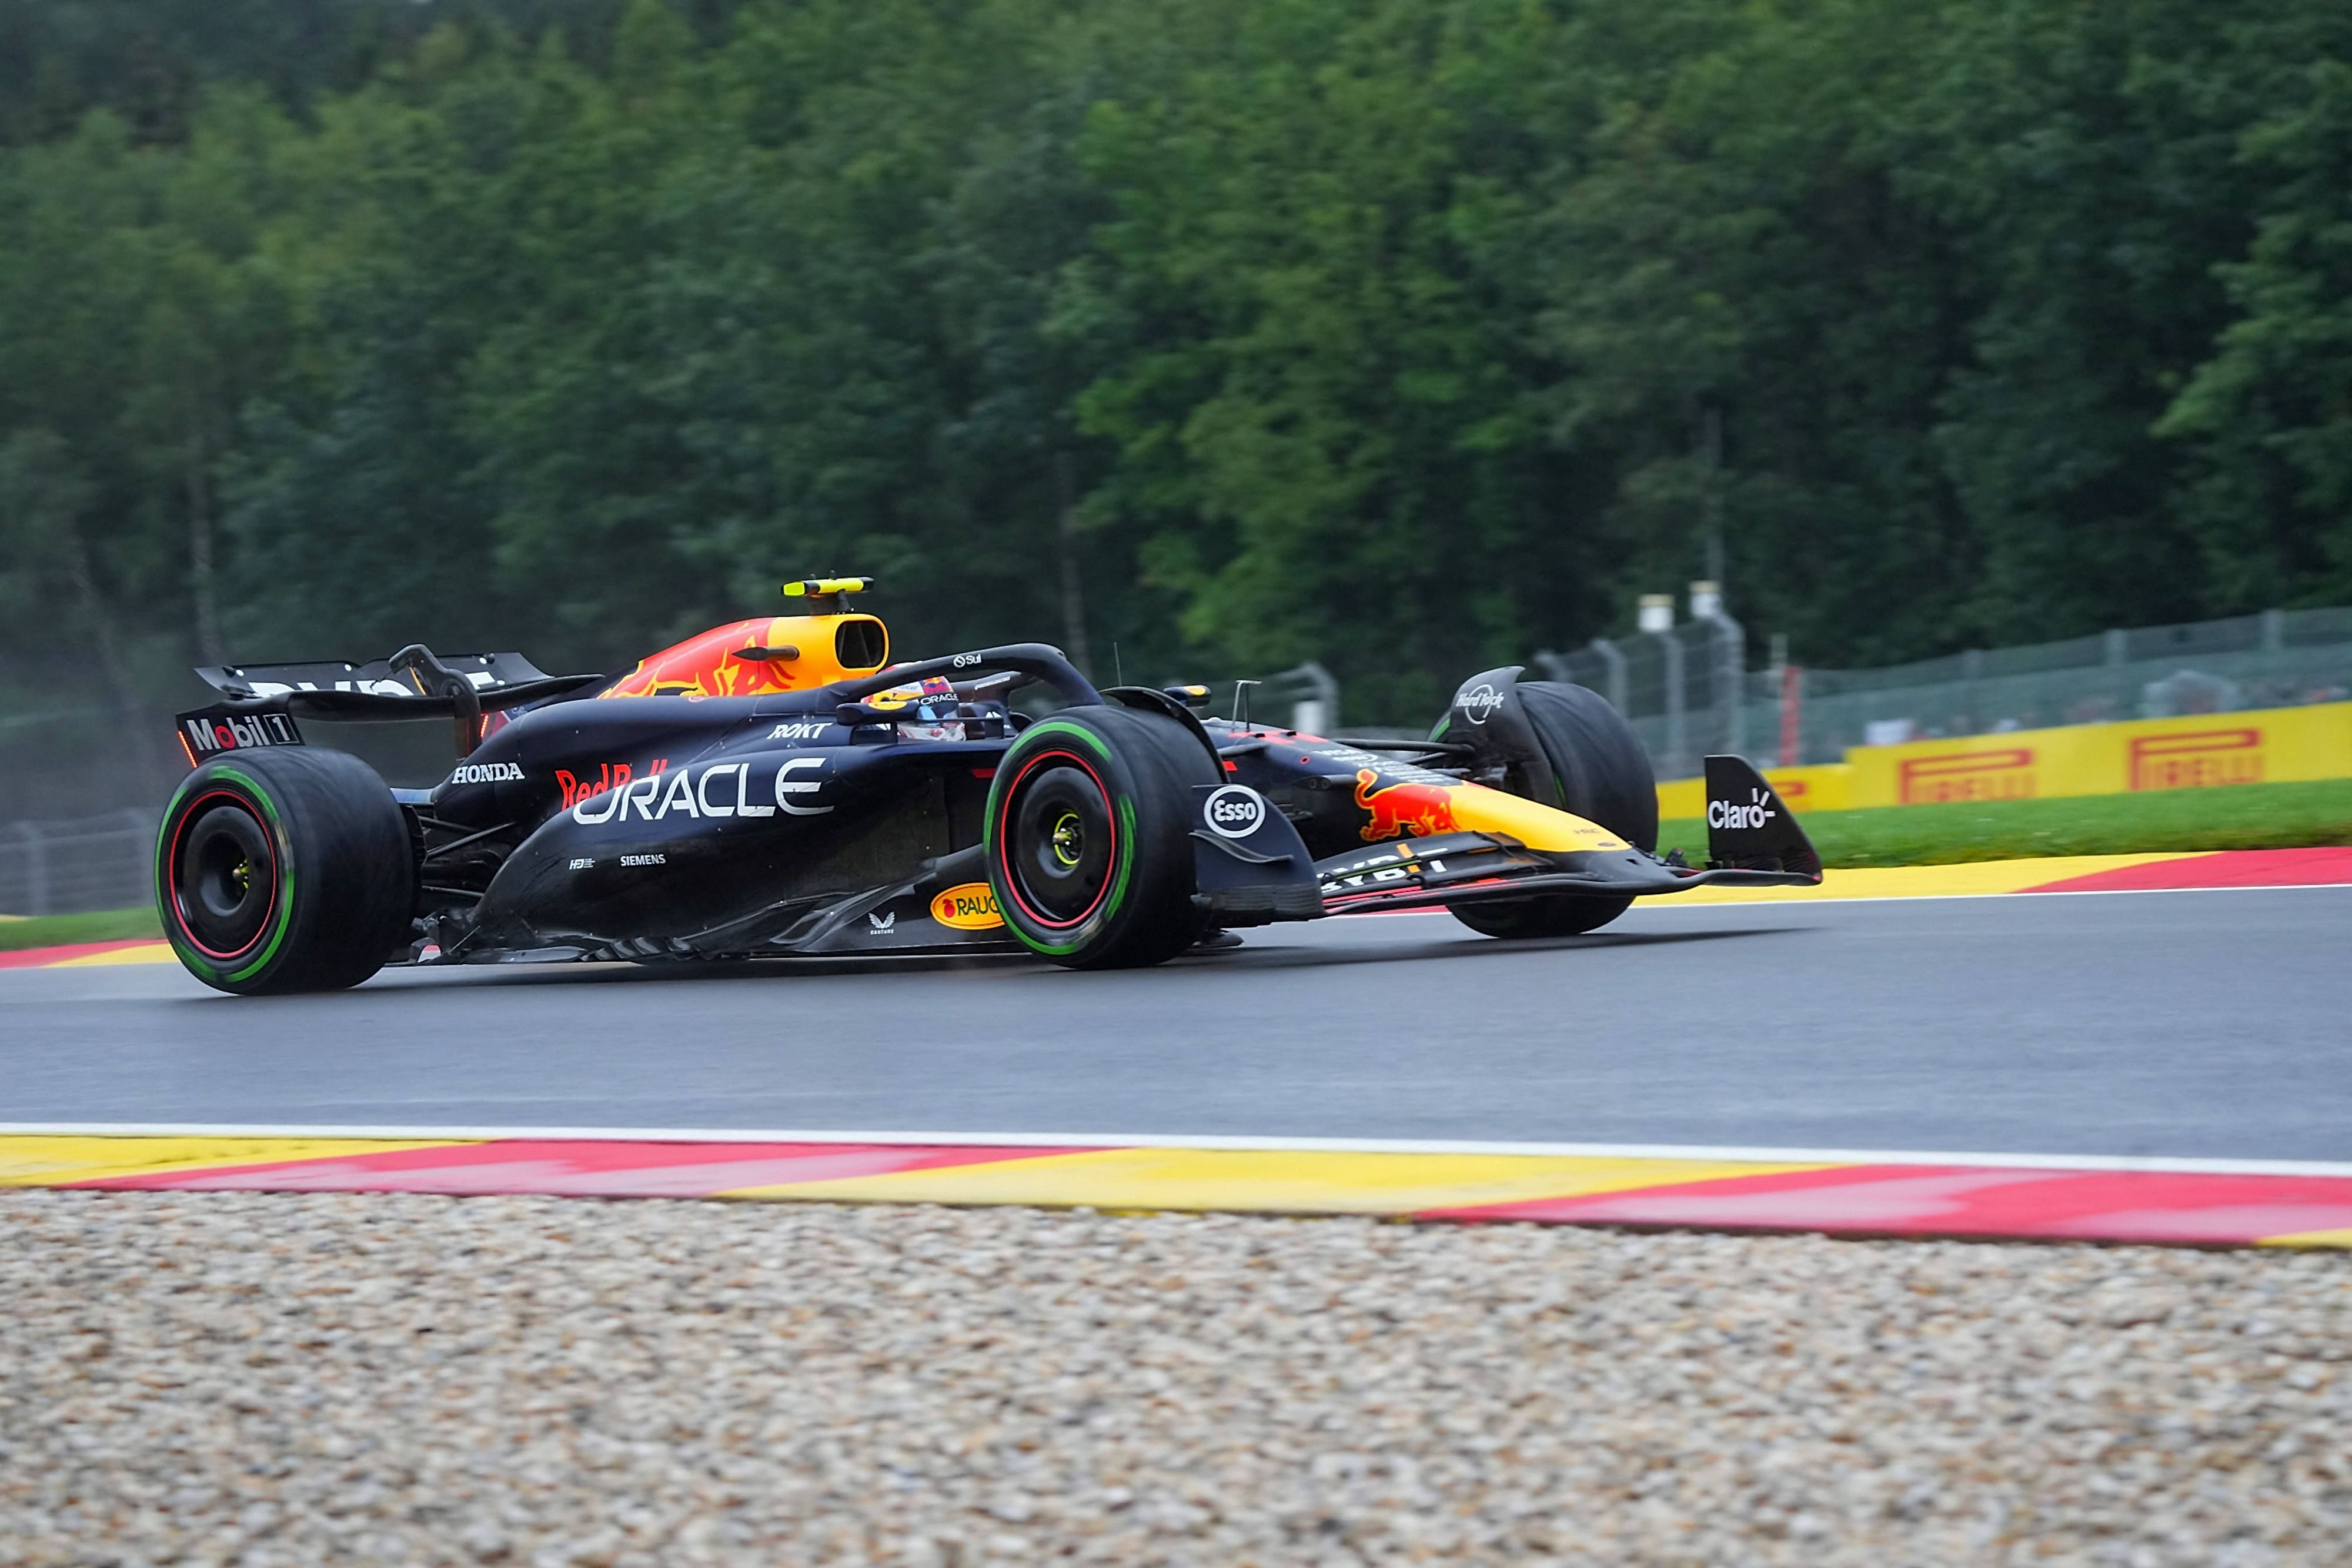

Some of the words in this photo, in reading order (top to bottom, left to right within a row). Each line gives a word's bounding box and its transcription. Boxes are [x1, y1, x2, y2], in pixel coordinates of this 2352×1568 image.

[965, 654, 981, 664] Sui
[186, 716, 270, 750] Mobil
[272, 717, 290, 741] 1
[766, 722, 833, 740] ROKT
[451, 763, 525, 784] HONDA
[573, 757, 835, 824] ORACLE
[1214, 800, 1257, 821] Esso
[1708, 800, 1766, 829] Claro
[620, 854, 666, 867] SIEMENS
[956, 896, 999, 916] RAUC
